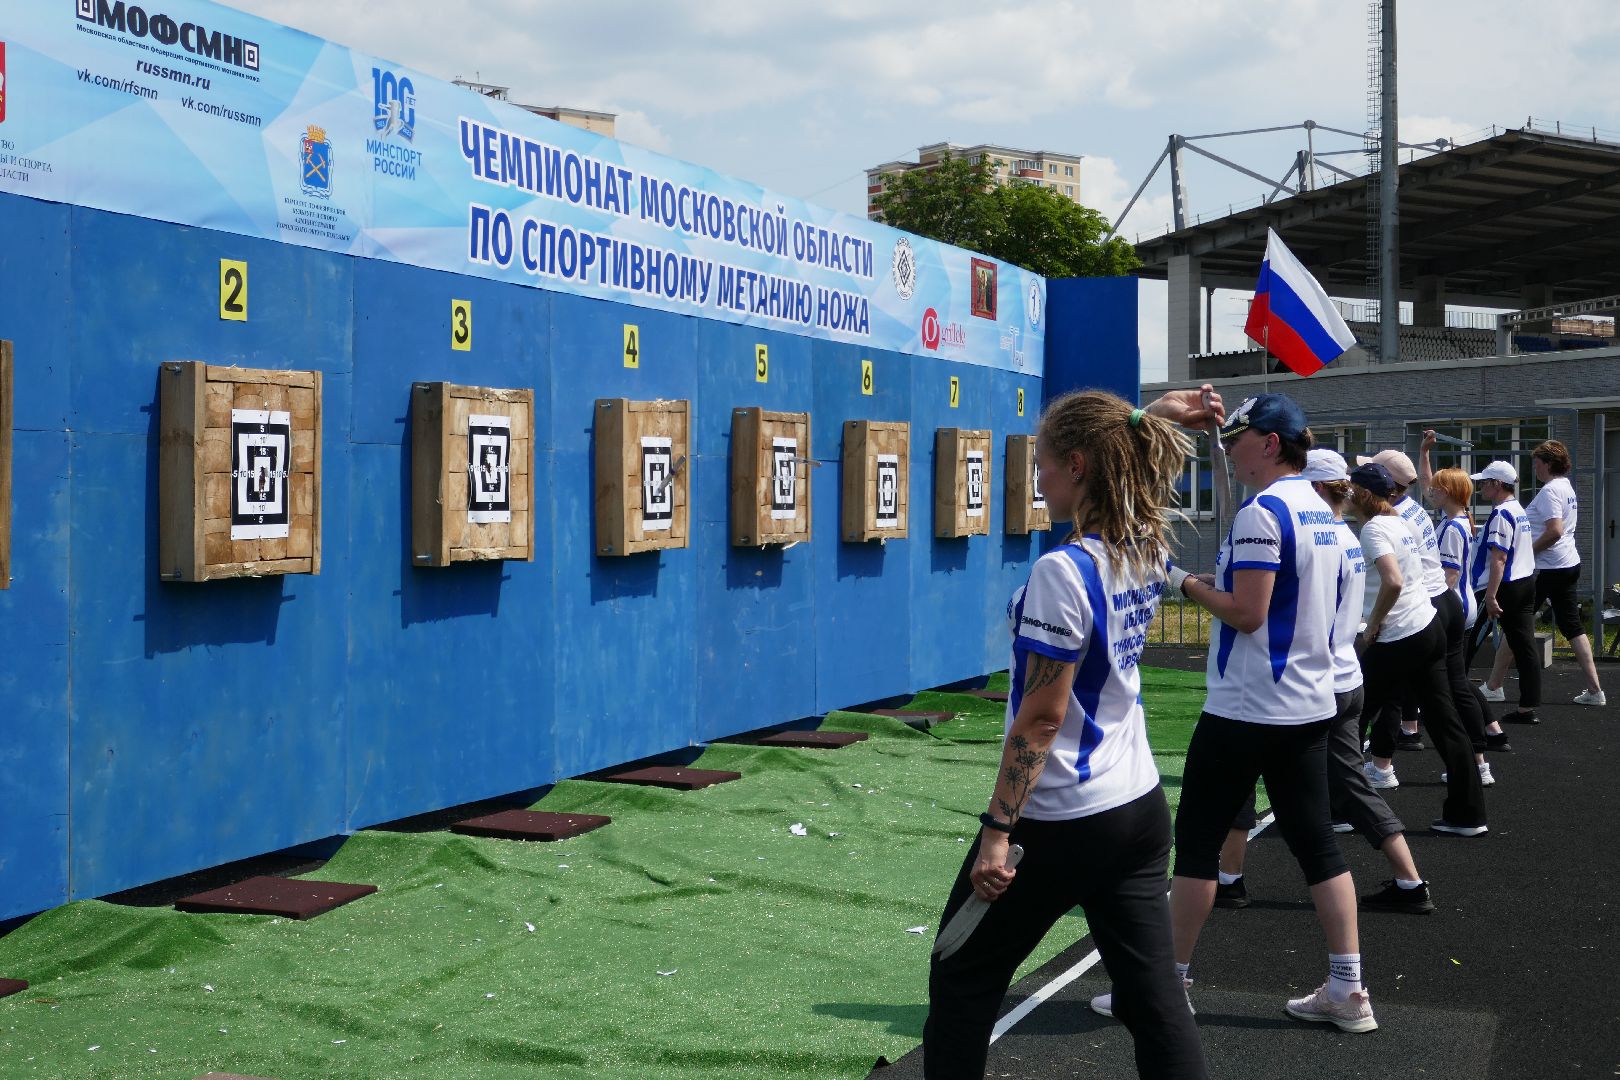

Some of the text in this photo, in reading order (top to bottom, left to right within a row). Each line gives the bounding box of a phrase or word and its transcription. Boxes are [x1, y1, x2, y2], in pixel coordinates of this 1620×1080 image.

[97, 0, 243, 68] МОФСМН
[77, 69, 159, 100] vk.com/rfsmn
[136, 58, 211, 91] russmn.ru
[181, 96, 262, 128] vk.com/russmn
[0, 139, 15, 151] ТВО
[366, 139, 422, 167] МИНСПОРТ
[0, 168, 29, 182] ЛАСТИ
[18, 157, 53, 173] СПОРТА
[374, 157, 416, 181] РОССИИ
[459, 119, 633, 216] ЧЕМПИОНАТ
[640, 175, 789, 258] МОСКОВСКОЙ
[793, 220, 873, 279] ОБЛАСТИ
[469, 205, 871, 335] ПО СПОРТИВНОМУ МЕТАНИЮ НОЖА
[224, 267, 244, 313] 2
[454, 305, 469, 344] 3
[625, 330, 638, 363] 4
[758, 348, 767, 377] 5
[863, 366, 871, 390] 6
[951, 380, 958, 403] 7
[260, 425, 265, 433] 5
[247, 470, 255, 478] 15
